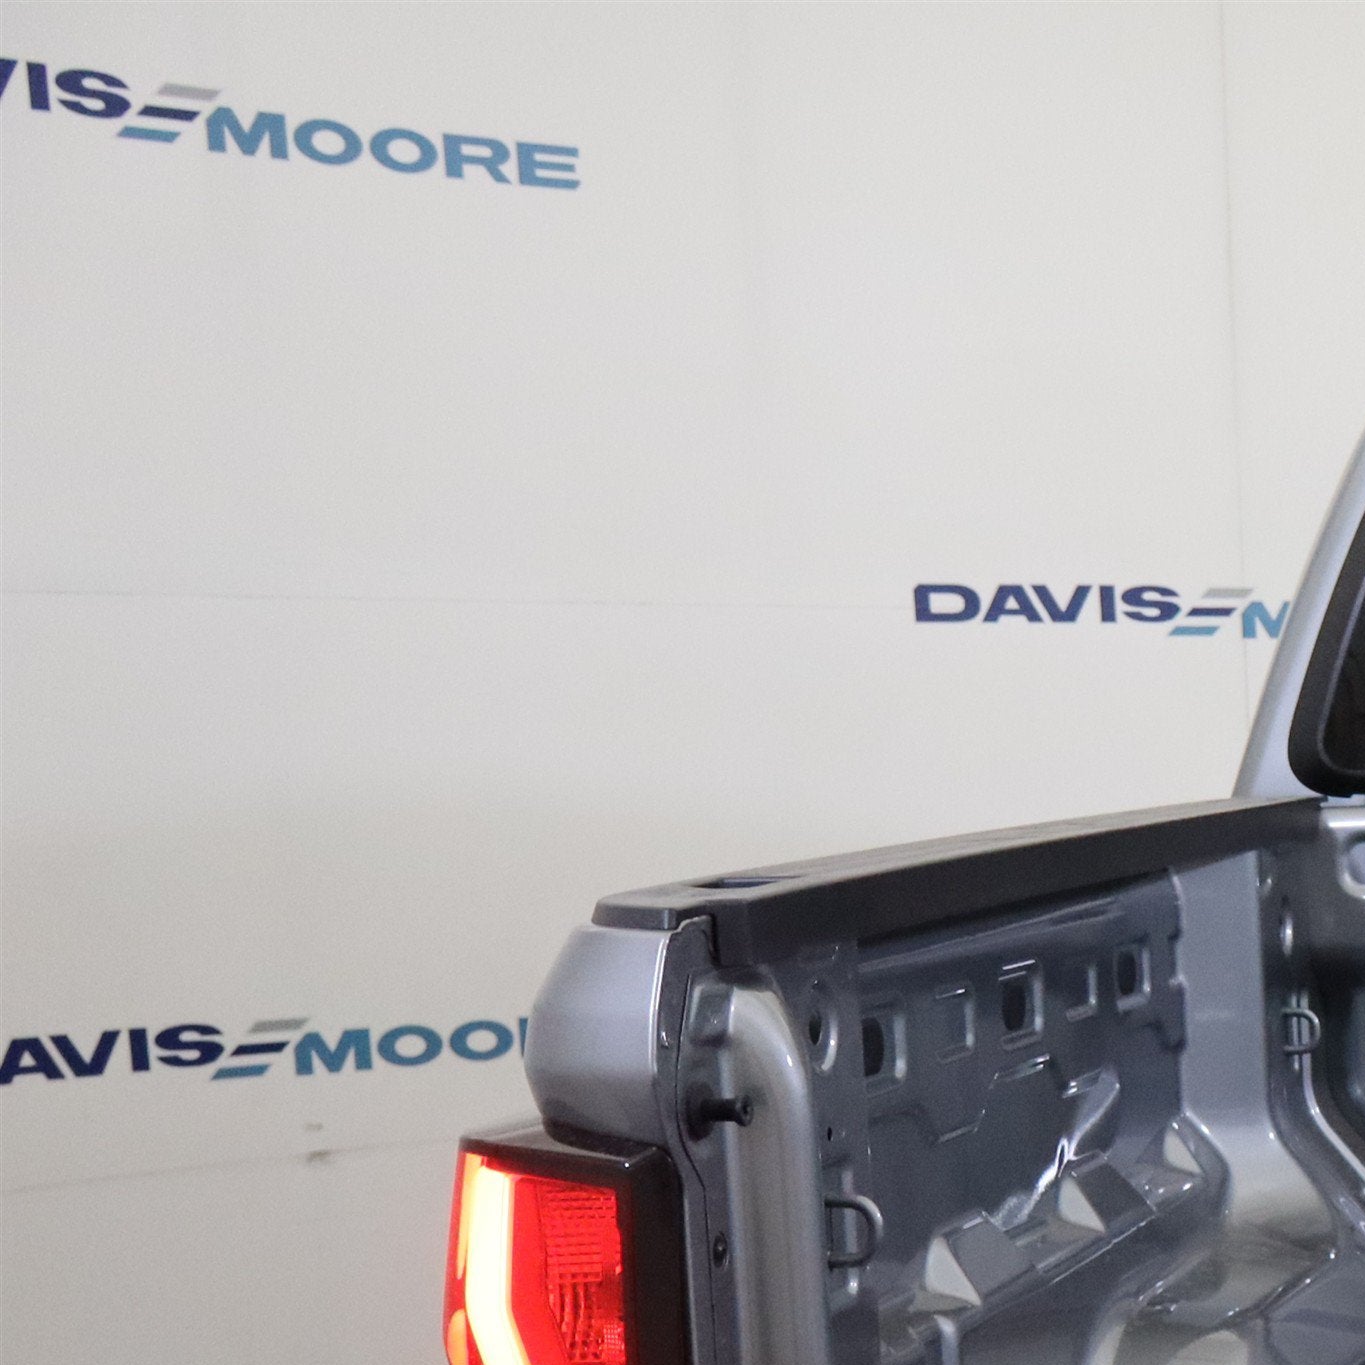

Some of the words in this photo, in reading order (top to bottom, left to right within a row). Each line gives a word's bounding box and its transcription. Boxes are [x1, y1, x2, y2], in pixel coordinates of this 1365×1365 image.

[205, 106, 581, 191] MOORE
[913, 583, 1182, 624] DAVIS
[293, 1016, 530, 1077] MOO
